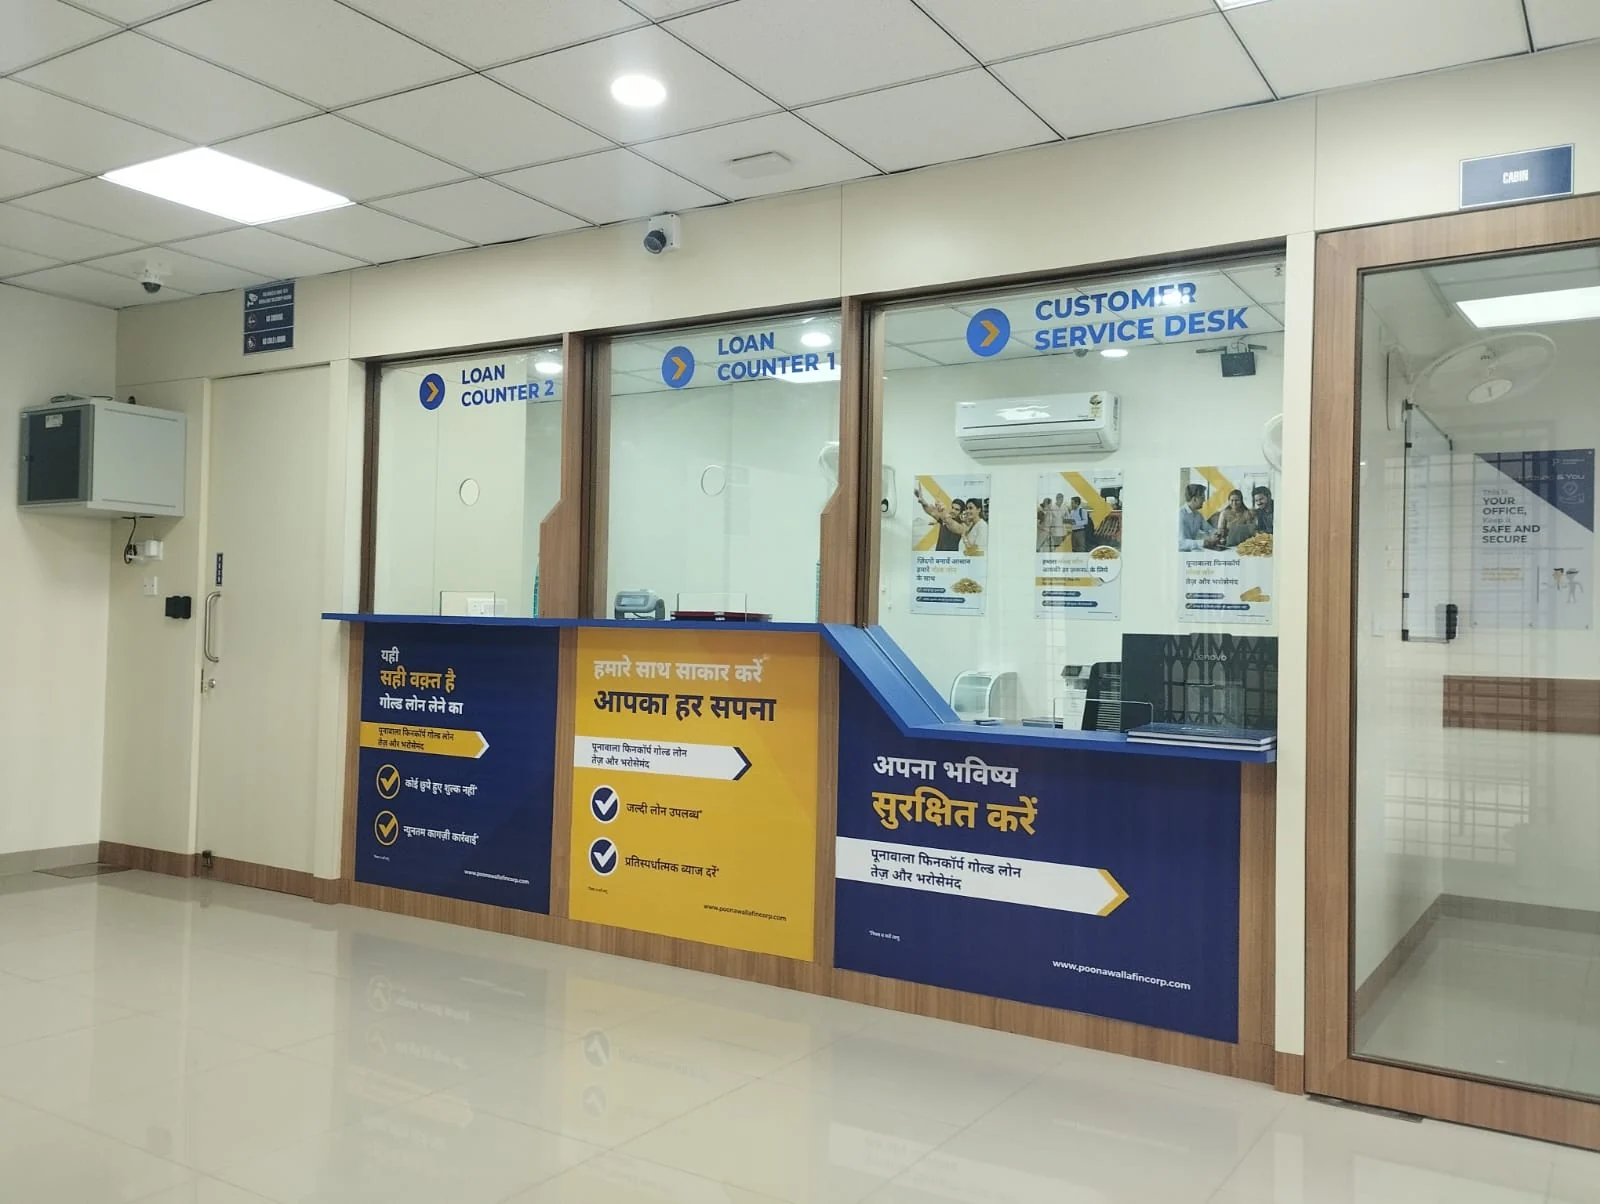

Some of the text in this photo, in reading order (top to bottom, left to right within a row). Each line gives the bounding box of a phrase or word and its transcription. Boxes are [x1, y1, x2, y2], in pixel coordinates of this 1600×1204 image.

[1502, 169, 1529, 184] CABIN
[1035, 282, 1197, 321] CUSTOMER
[1035, 307, 1249, 350] SERVICE DESK
[718, 332, 775, 355] LOAN
[461, 364, 505, 385] LOAN
[717, 351, 835, 381] COUNTER 1
[461, 379, 554, 406] COUNTER 2
[1482, 497, 1515, 505] YOUR
[1482, 507, 1527, 516] OFFICE,
[1482, 525, 1541, 533] SAFE AND
[1482, 535, 1528, 543] SECURE
[381, 646, 399, 664] यही
[1193, 652, 1228, 661] Lenovo
[593, 654, 632, 680] हमारे
[636, 660, 671, 679] साथ
[676, 662, 730, 682] साकार
[380, 665, 456, 693] सही वक़्त है
[380, 693, 464, 714] गोल्ड लोन लेने का
[594, 690, 777, 722] आपका हर सपना
[389, 738, 400, 748] और
[592, 742, 687, 757] पूनावाला फिनकॉर्प गोल्ड लोन
[592, 754, 650, 768] तेज़ और भरोसेमंद
[873, 755, 1019, 788] अपना भविष्य
[405, 777, 419, 789] कोई
[432, 782, 443, 794] हुए
[444, 784, 461, 795] शुल्क
[626, 802, 648, 815] जल्दी
[650, 803, 667, 816] लोन
[871, 786, 1038, 835] सुरक्षित करें
[403, 825, 426, 838] न्यूनतम
[625, 854, 679, 872] प्रतिस्पर्धात्मक
[681, 864, 704, 876] ब्याज
[871, 849, 1021, 878] पूनावाला फिनकॉर्प गोल्ड लोन
[870, 864, 962, 890] तेज़ और भरोसेमंद
[1052, 959, 1191, 990] www.poonawallafincorp.com
